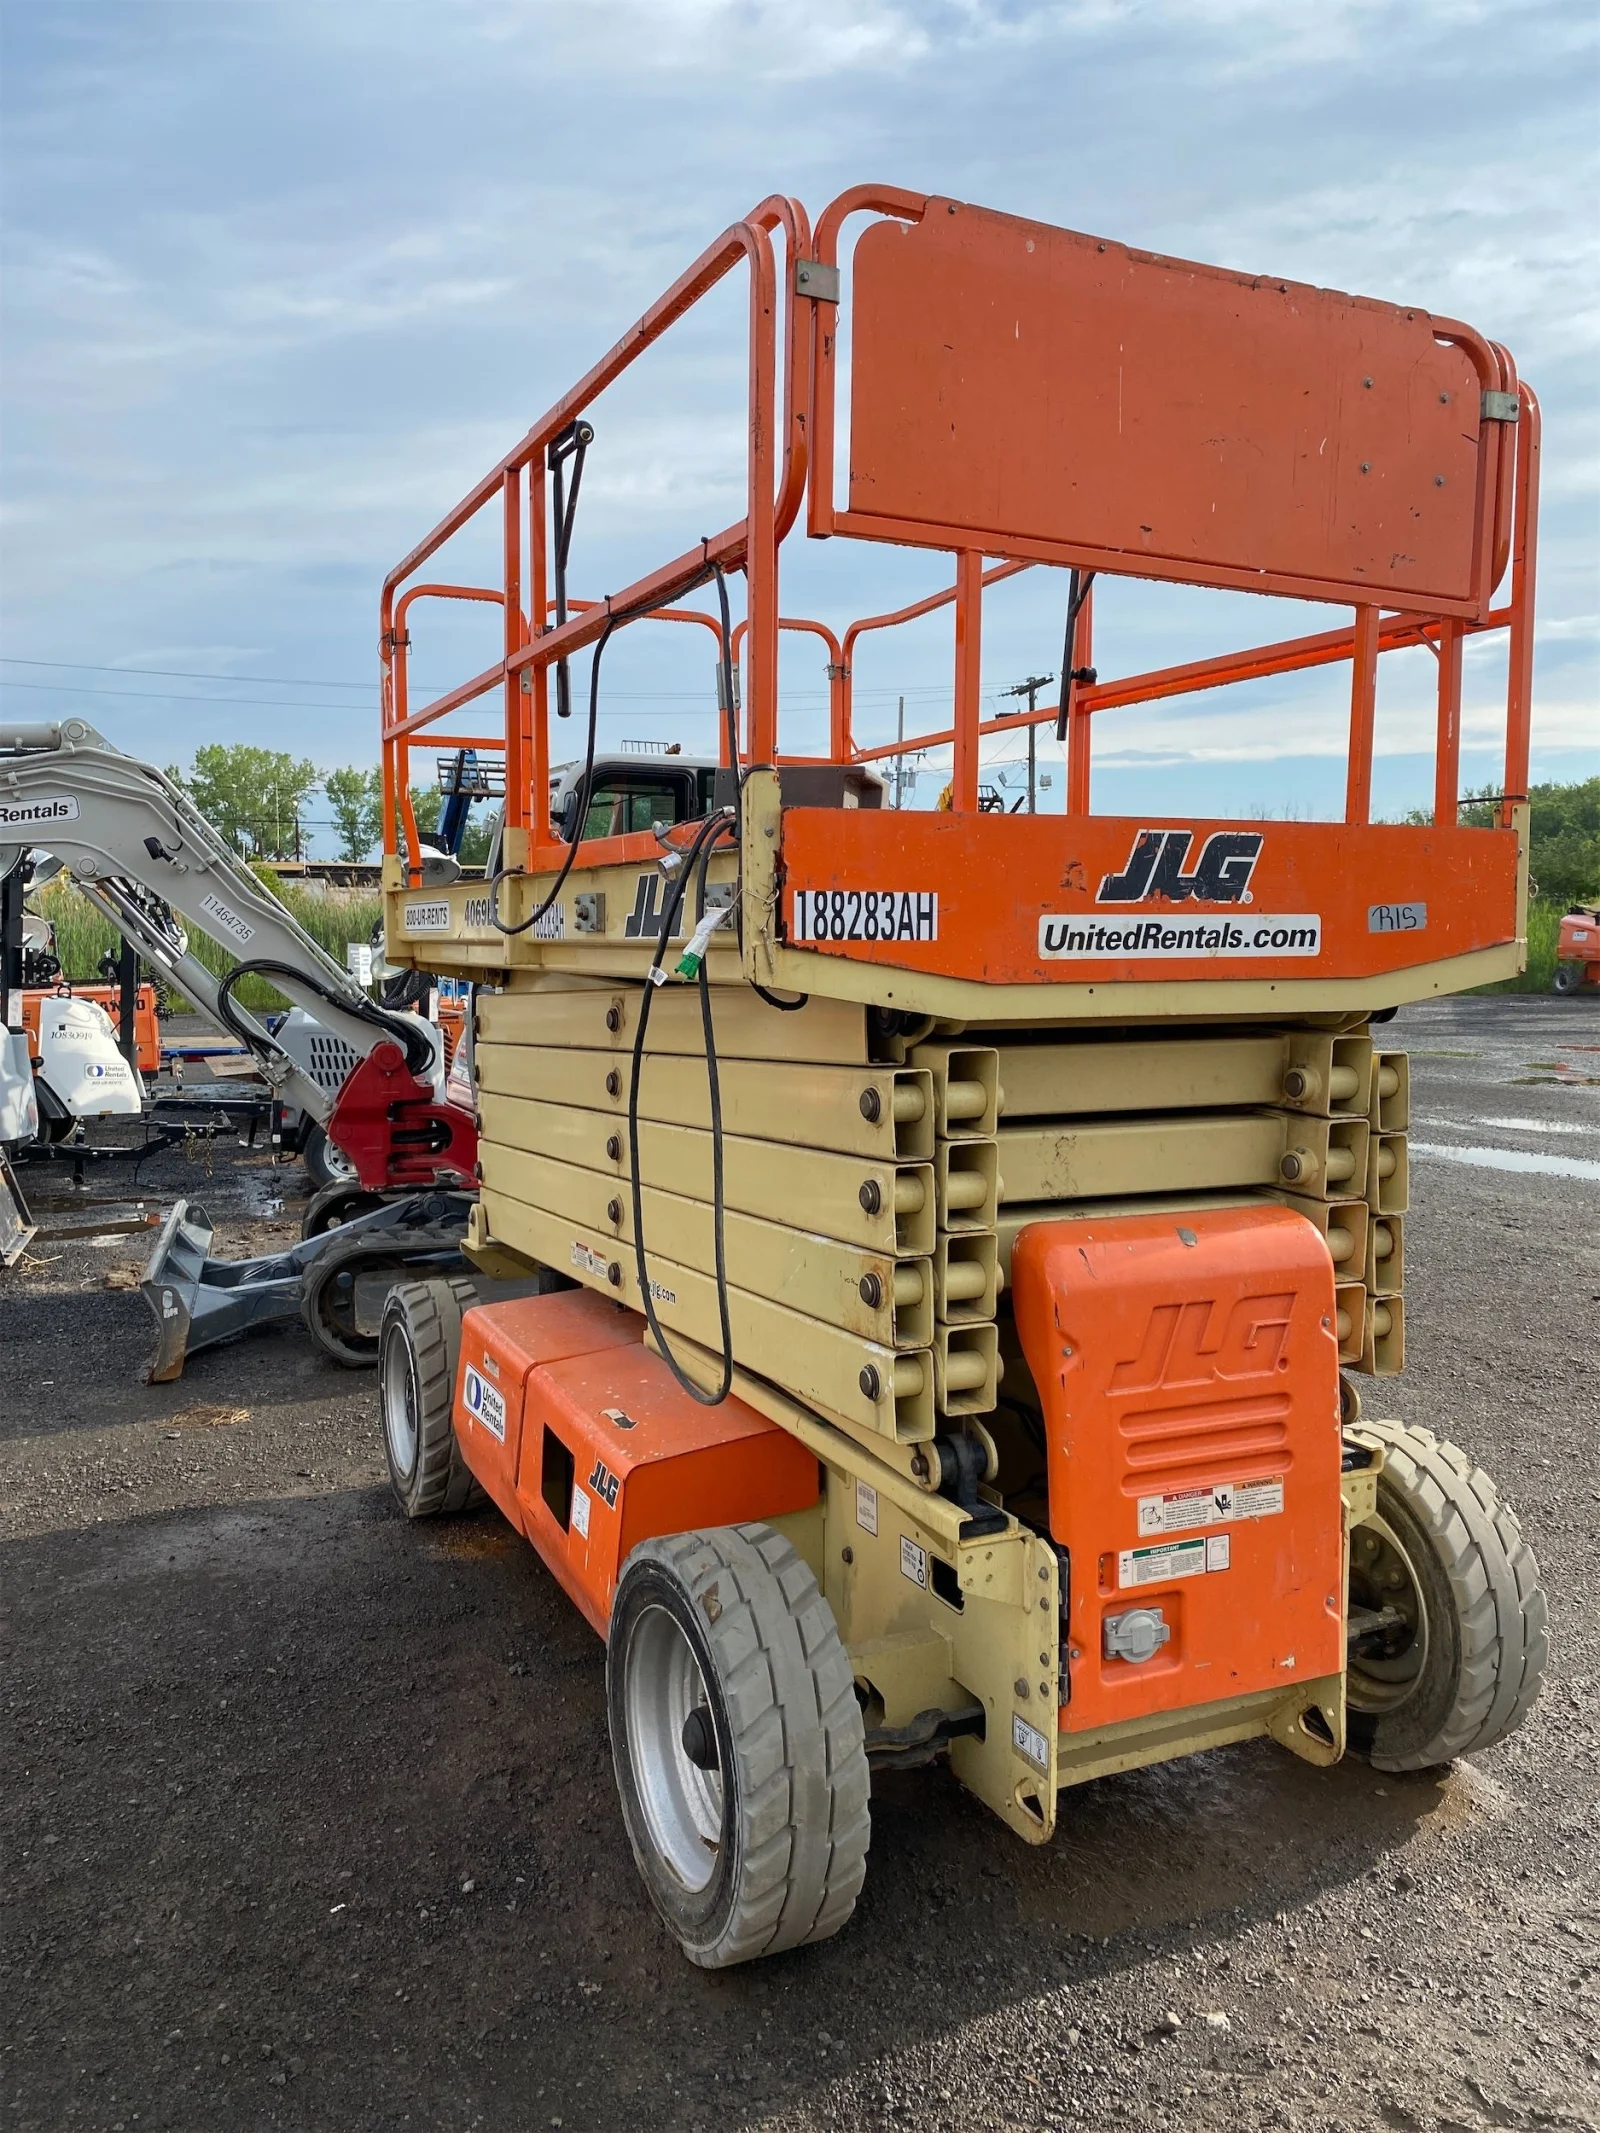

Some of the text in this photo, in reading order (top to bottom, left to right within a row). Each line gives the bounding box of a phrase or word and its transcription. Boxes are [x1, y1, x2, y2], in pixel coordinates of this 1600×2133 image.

[1095, 829, 1264, 903] JLG
[204, 895, 252, 940] 11464735
[405, 906, 448, 927] 800-UR-RENTS
[796, 890, 934, 941] 188283AH
[1044, 922, 1317, 951] UnitedRentals.com
[1105, 1291, 1298, 1396] JLG
[482, 1384, 503, 1418] United
[481, 1402, 504, 1436] Rentals
[588, 1459, 620, 1511] JLG
[1178, 1490, 1203, 1500] DANGER
[1150, 1544, 1180, 1554] IMPORTANT
